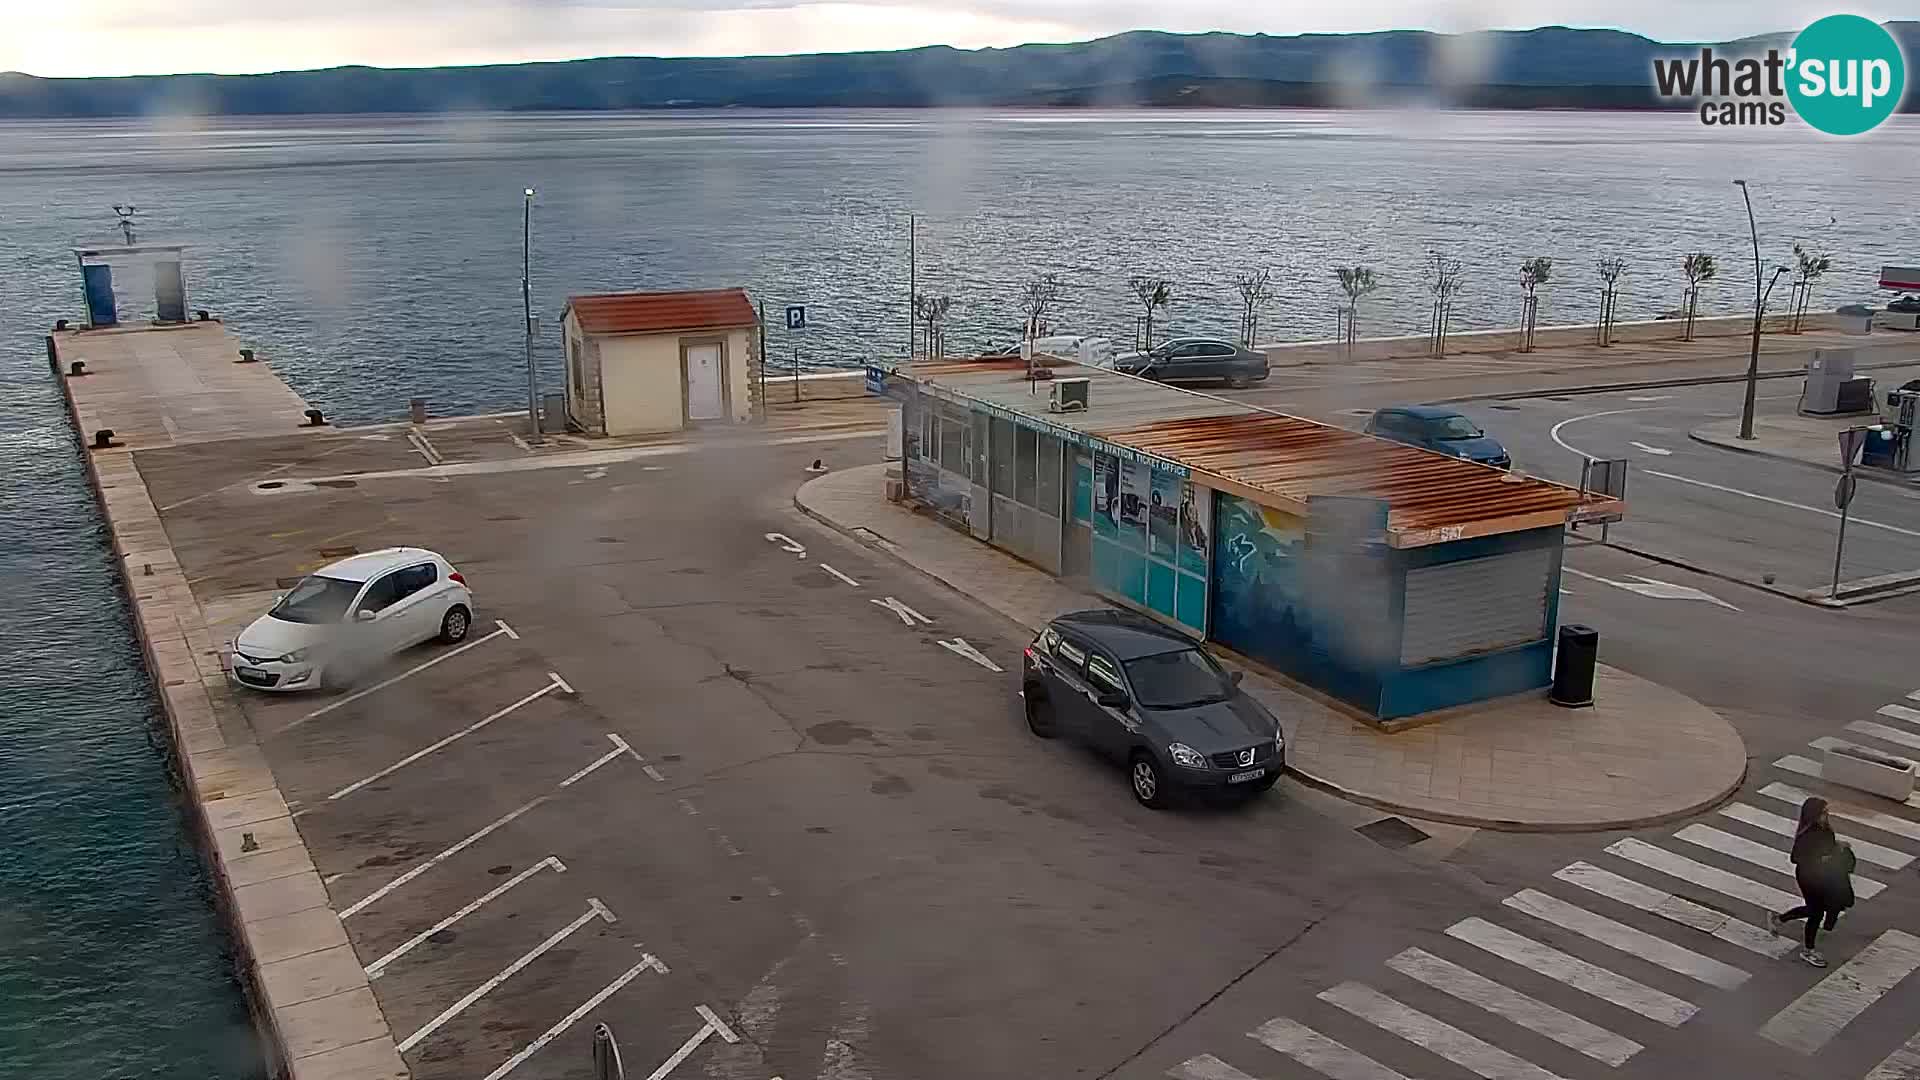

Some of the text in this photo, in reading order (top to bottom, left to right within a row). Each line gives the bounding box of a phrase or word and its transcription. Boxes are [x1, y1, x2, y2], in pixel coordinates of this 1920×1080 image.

[790, 309, 801, 327] P
[1089, 438, 1103, 450] BUS
[1104, 444, 1134, 461] STATION
[1135, 453, 1161, 469] TICKET
[1161, 462, 1187, 477] OFFICE
